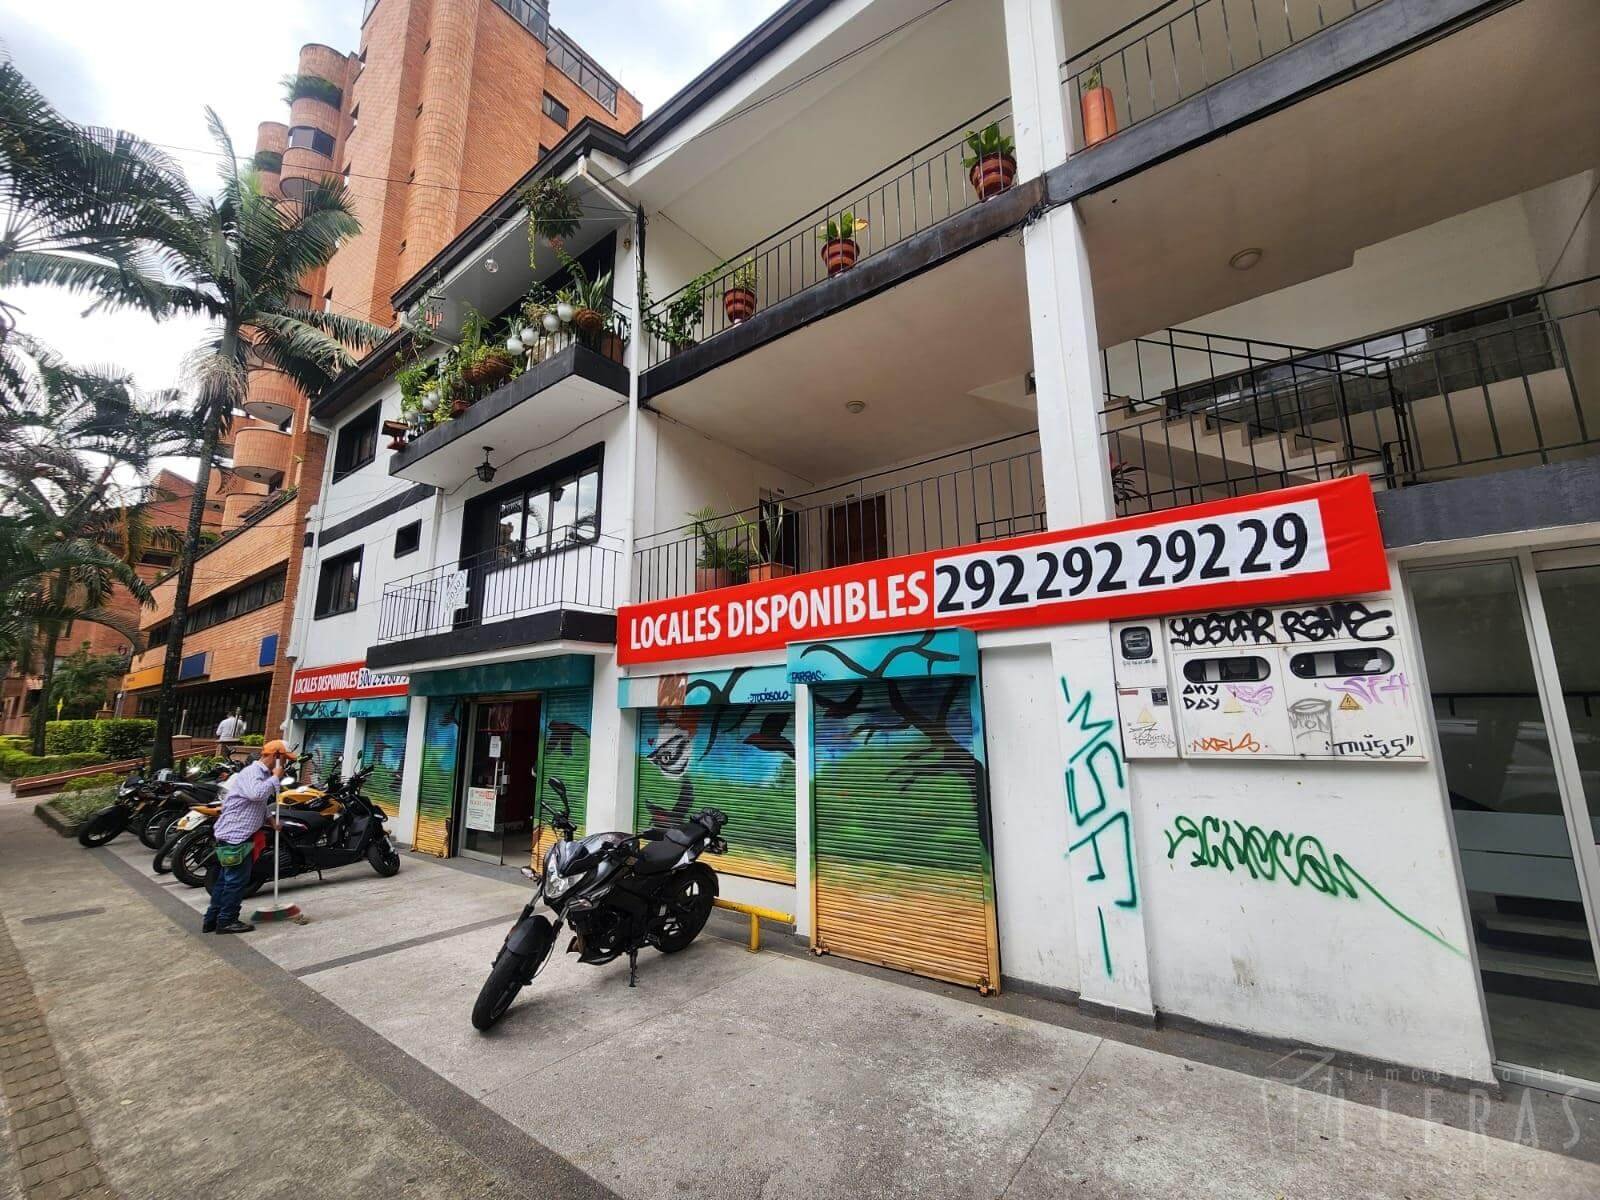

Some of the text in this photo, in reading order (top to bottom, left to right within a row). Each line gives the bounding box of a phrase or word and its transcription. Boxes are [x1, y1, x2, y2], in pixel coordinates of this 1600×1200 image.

[630, 512, 1308, 650] LOCALES DISPONIBLES 292 292 292 29
[294, 676, 317, 694] LOCALES
[317, 670, 358, 691] DISPONIBLES
